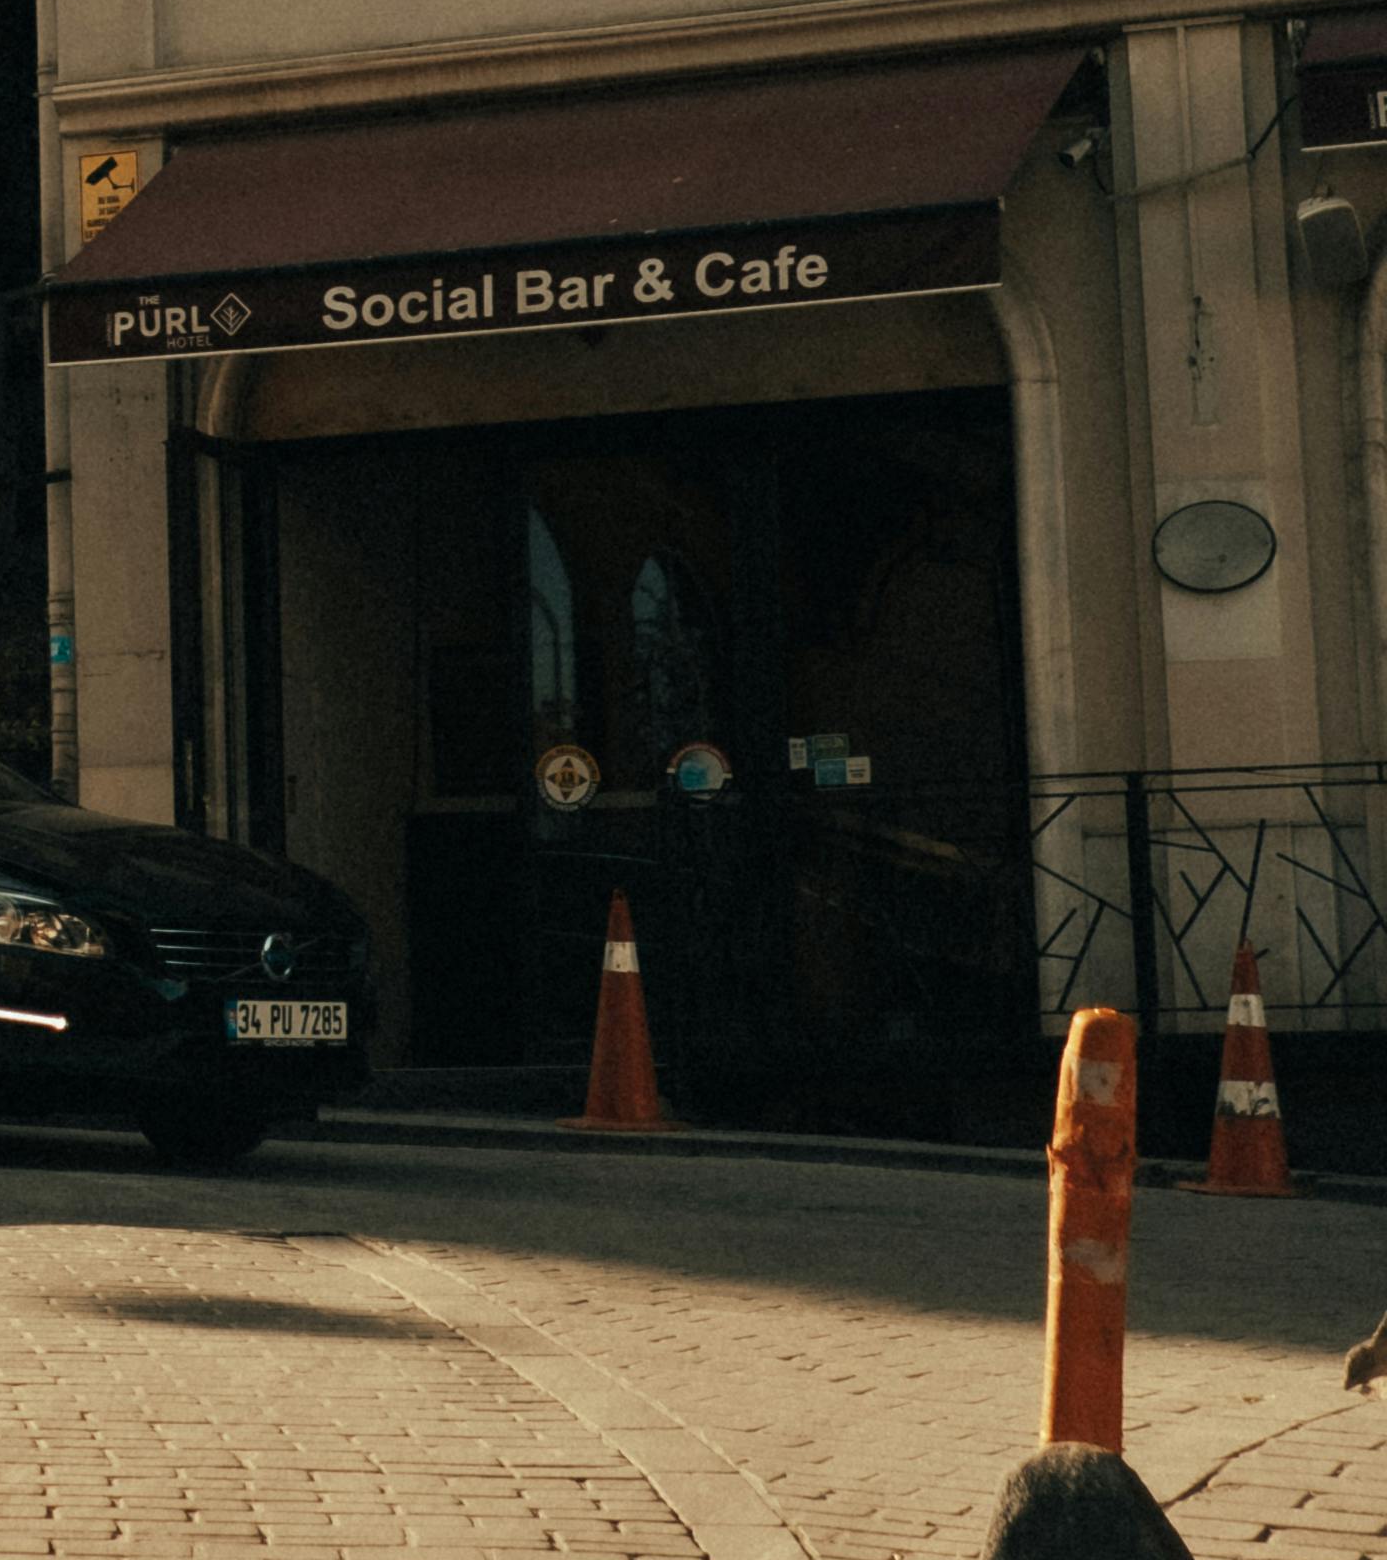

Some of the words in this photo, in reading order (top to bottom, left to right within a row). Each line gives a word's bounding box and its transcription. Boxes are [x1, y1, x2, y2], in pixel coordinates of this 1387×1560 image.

[138, 294, 161, 306] THE
[321, 273, 495, 330] Social
[515, 269, 615, 315] Bar
[632, 257, 675, 304] &
[693, 245, 829, 297] Cafe
[113, 305, 211, 347] PURL
[167, 334, 214, 349] HOTEL
[238, 1004, 261, 1034] 34
[270, 1004, 293, 1035] PU
[300, 1004, 343, 1035] 7285
